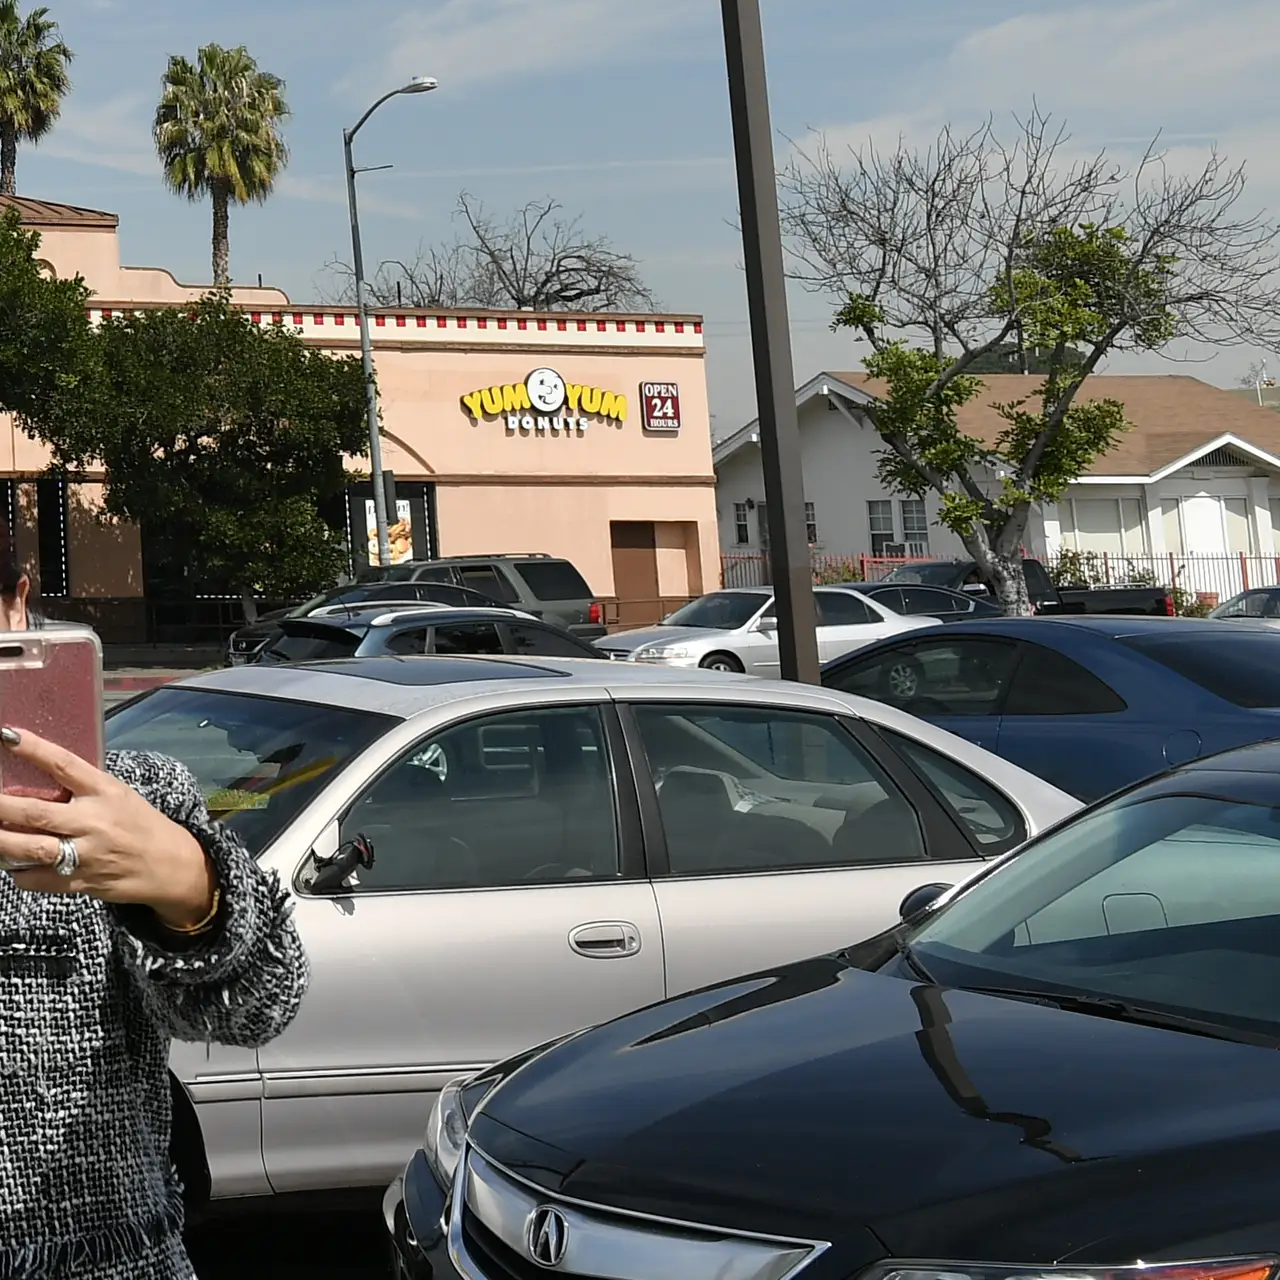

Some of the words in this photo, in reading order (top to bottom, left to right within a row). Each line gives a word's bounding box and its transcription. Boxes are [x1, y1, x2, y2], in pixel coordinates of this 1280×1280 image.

[644, 383, 678, 397] OPEN
[462, 383, 531, 419] YUM
[565, 383, 628, 421] YUM
[651, 398, 675, 418] 24
[506, 414, 589, 431] DONUTS
[650, 419, 679, 428] HOURS
